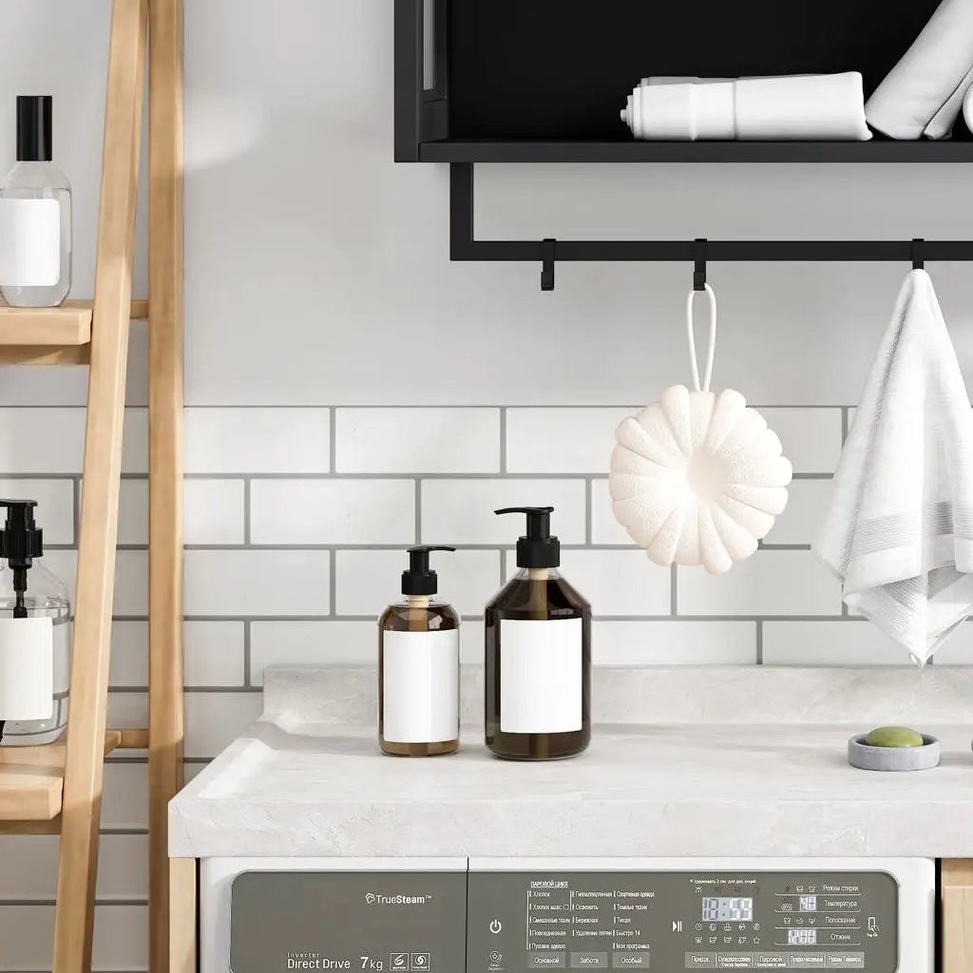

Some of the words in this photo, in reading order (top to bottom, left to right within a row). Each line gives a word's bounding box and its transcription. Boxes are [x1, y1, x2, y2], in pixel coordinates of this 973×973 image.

[824, 900, 857, 908] Температура
[287, 959, 320, 969] Direct
[322, 959, 351, 969] Drive
